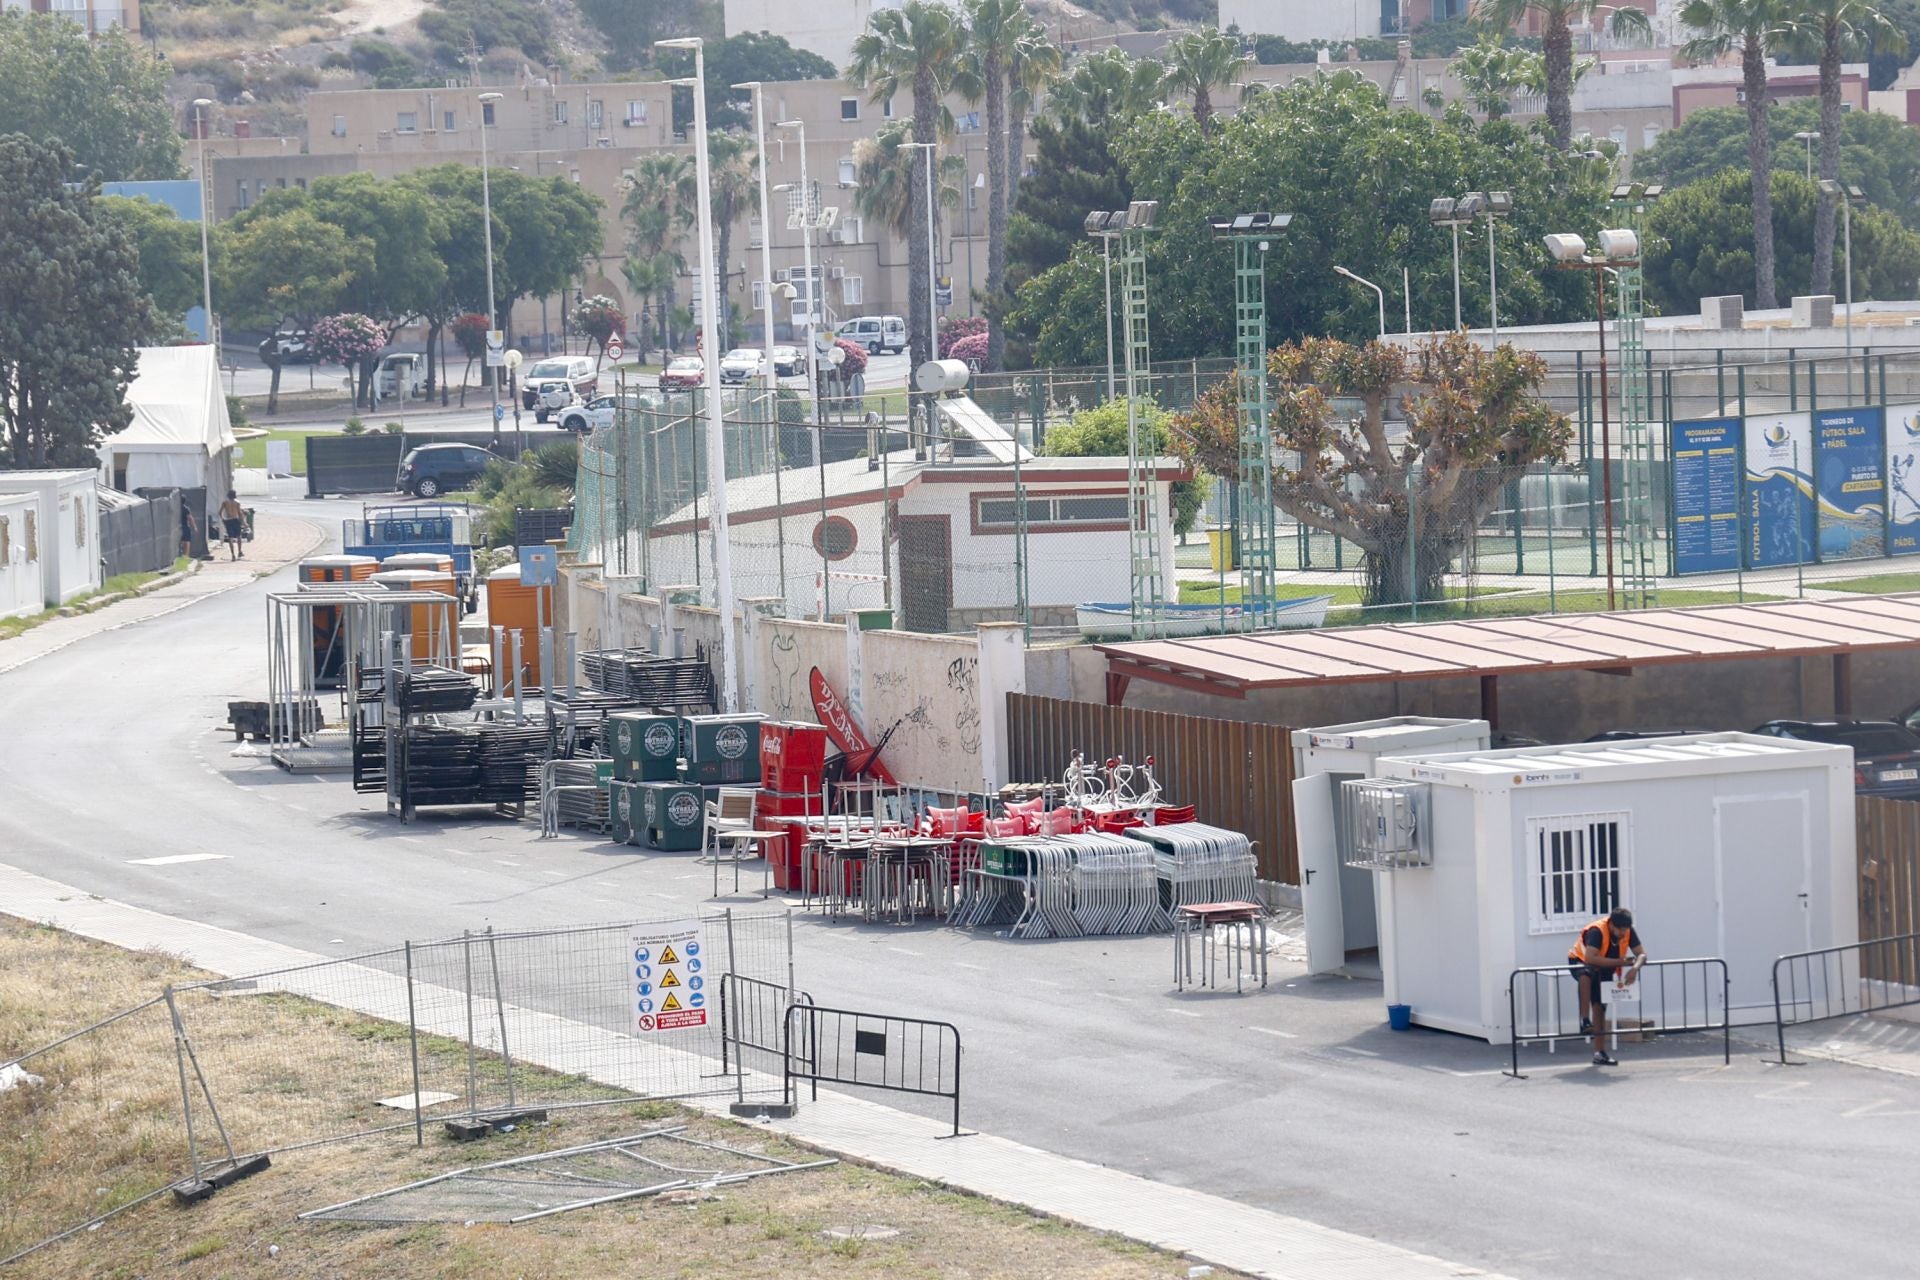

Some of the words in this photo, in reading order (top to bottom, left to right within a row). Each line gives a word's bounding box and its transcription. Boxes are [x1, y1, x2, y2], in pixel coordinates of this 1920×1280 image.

[1821, 427, 1847, 437] FÚTBOL
[1847, 427, 1866, 436] SALA
[1827, 438, 1848, 448] PÁDEL
[1752, 489, 1760, 518] SALA
[1894, 537, 1916, 547] PÁDEL
